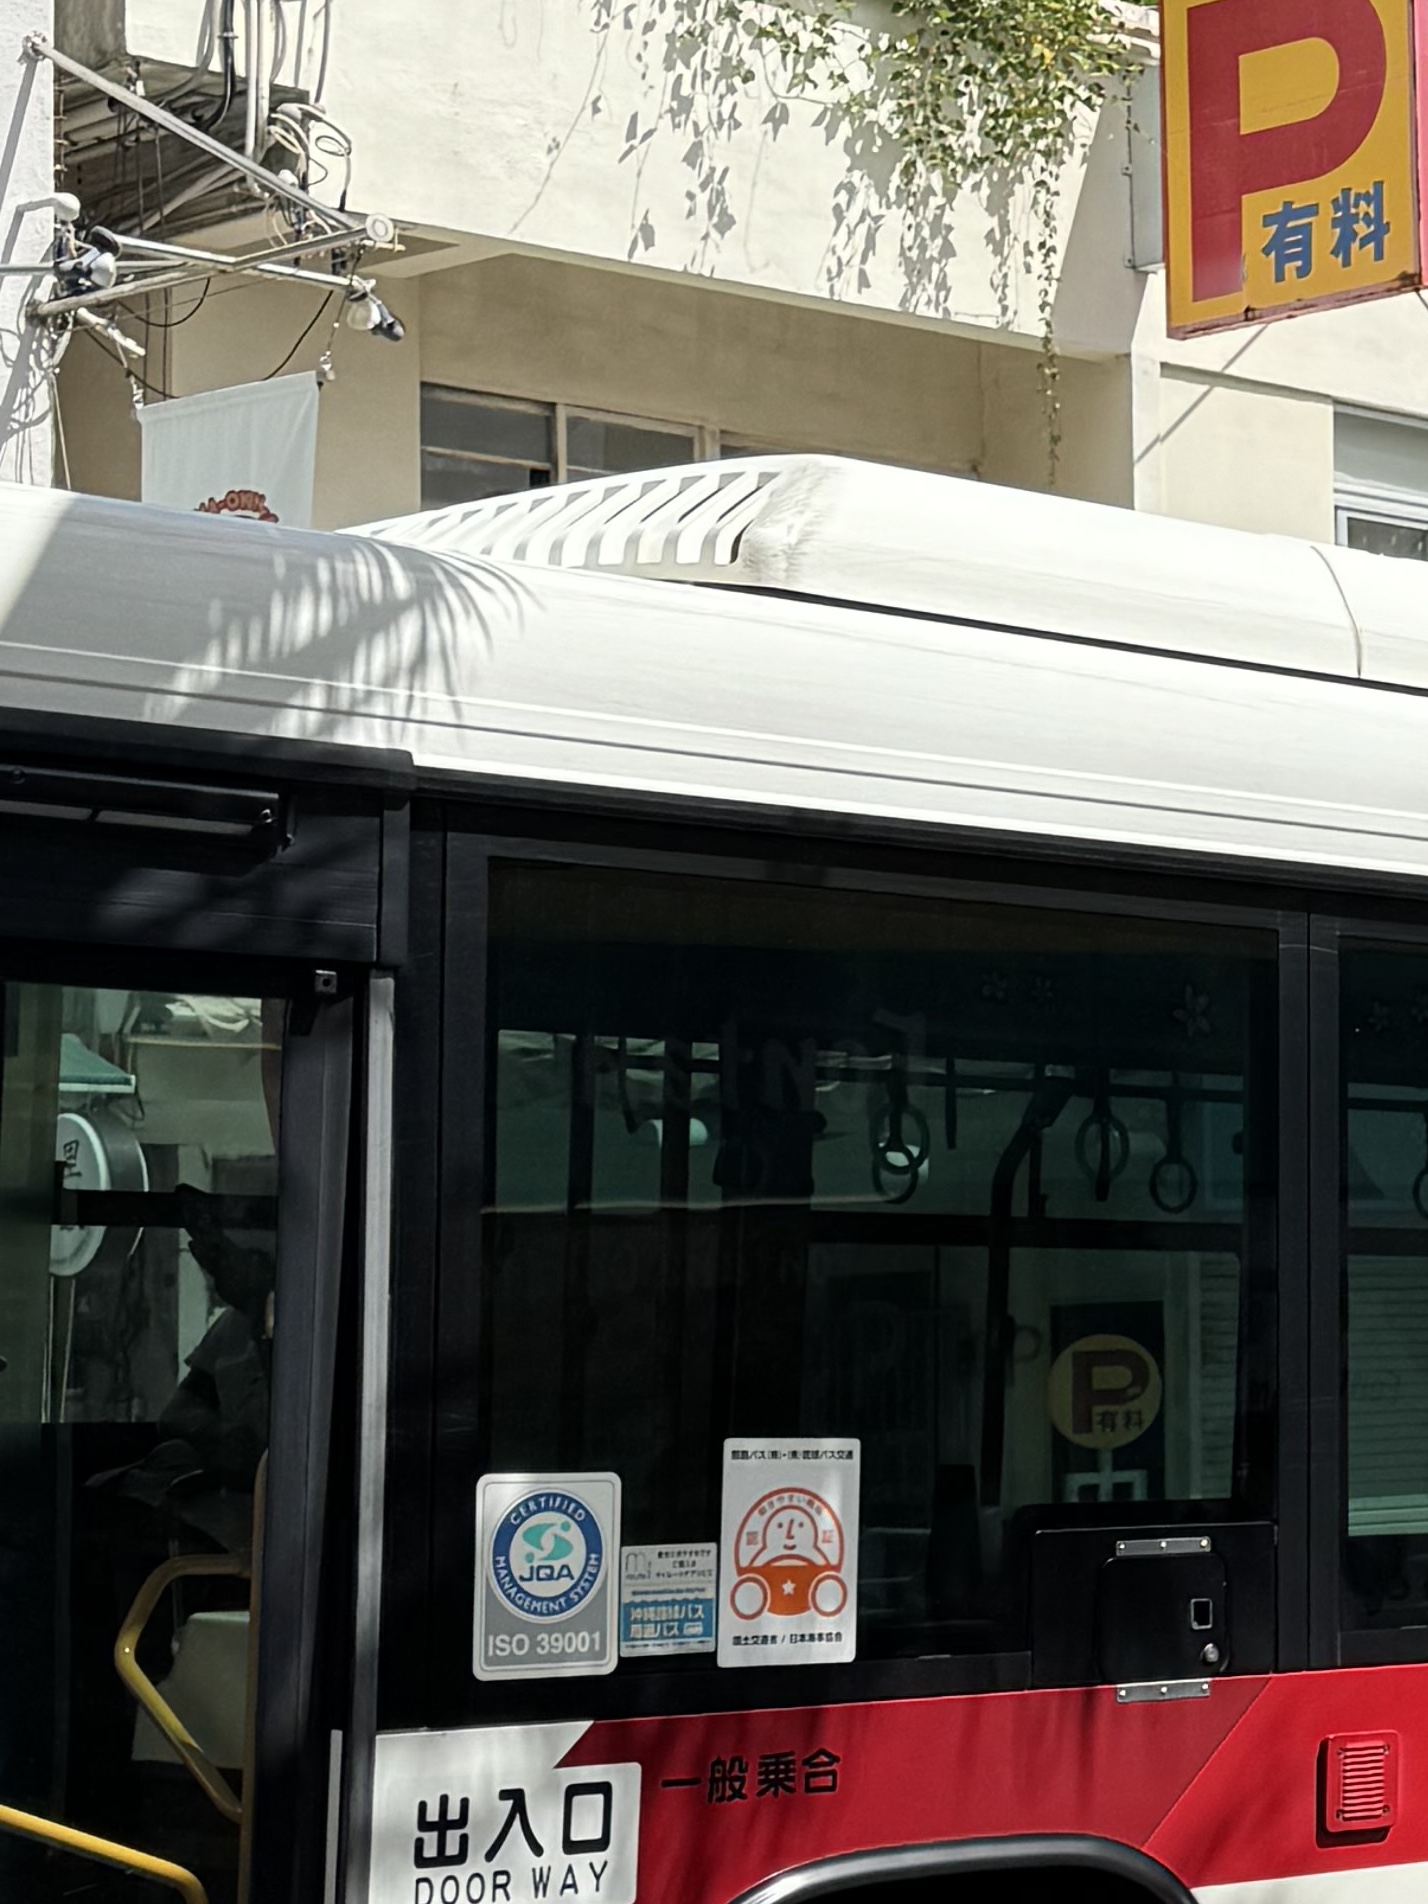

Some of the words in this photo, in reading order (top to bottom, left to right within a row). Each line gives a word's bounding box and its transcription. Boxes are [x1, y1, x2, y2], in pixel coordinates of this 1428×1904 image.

[1262, 180, 1391, 283] 有料
[1072, 1349, 1149, 1433] P
[510, 1496, 586, 1525] CERTIFIED
[495, 1555, 567, 1614] MANAGEMENT
[569, 1552, 600, 1602] SYSTEM
[519, 1564, 575, 1582] JQA
[488, 1633, 530, 1657] ISO
[536, 1630, 600, 1655] 39001
[661, 1747, 841, 1804] 一般乗合
[414, 1781, 613, 1869] 出入口
[531, 1859, 609, 1899] WAY
